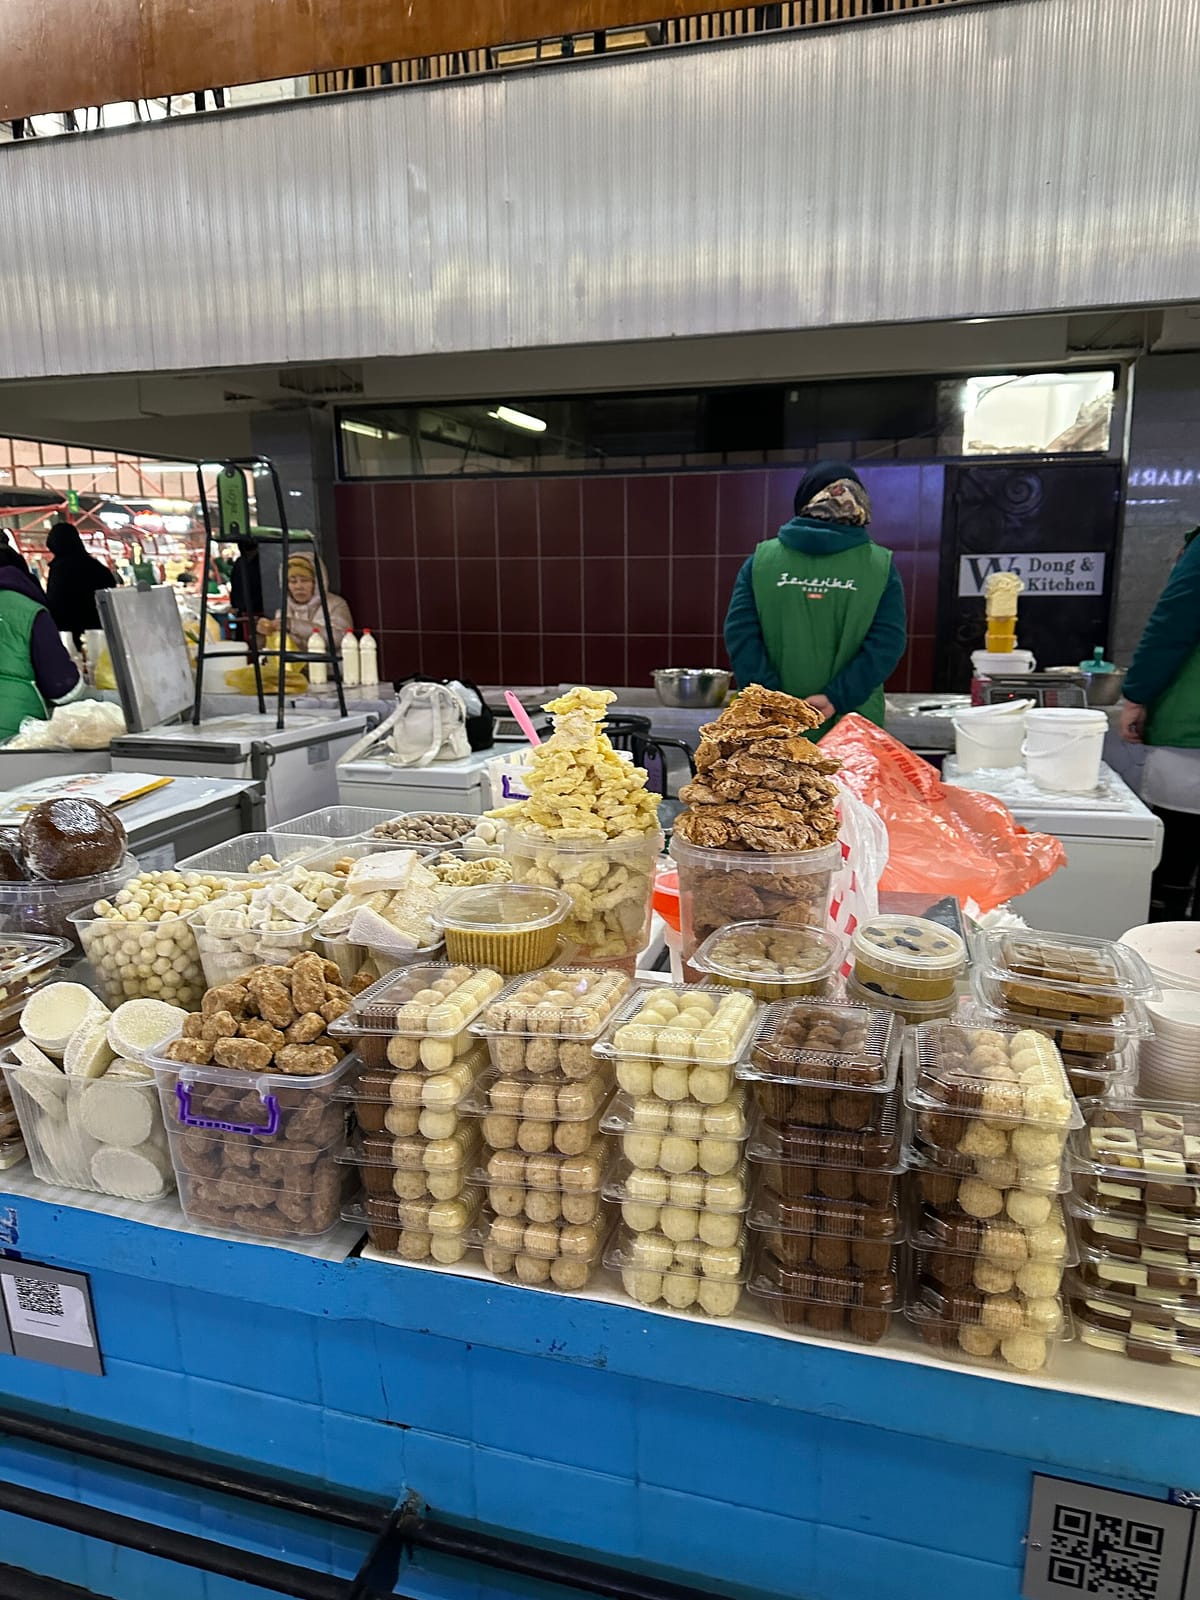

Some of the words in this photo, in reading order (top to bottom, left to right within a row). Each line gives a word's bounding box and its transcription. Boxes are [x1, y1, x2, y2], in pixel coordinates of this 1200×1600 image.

[1028, 558, 1076, 574] Dong
[1080, 557, 1094, 572] &
[1028, 577, 1096, 591] Kitchen
